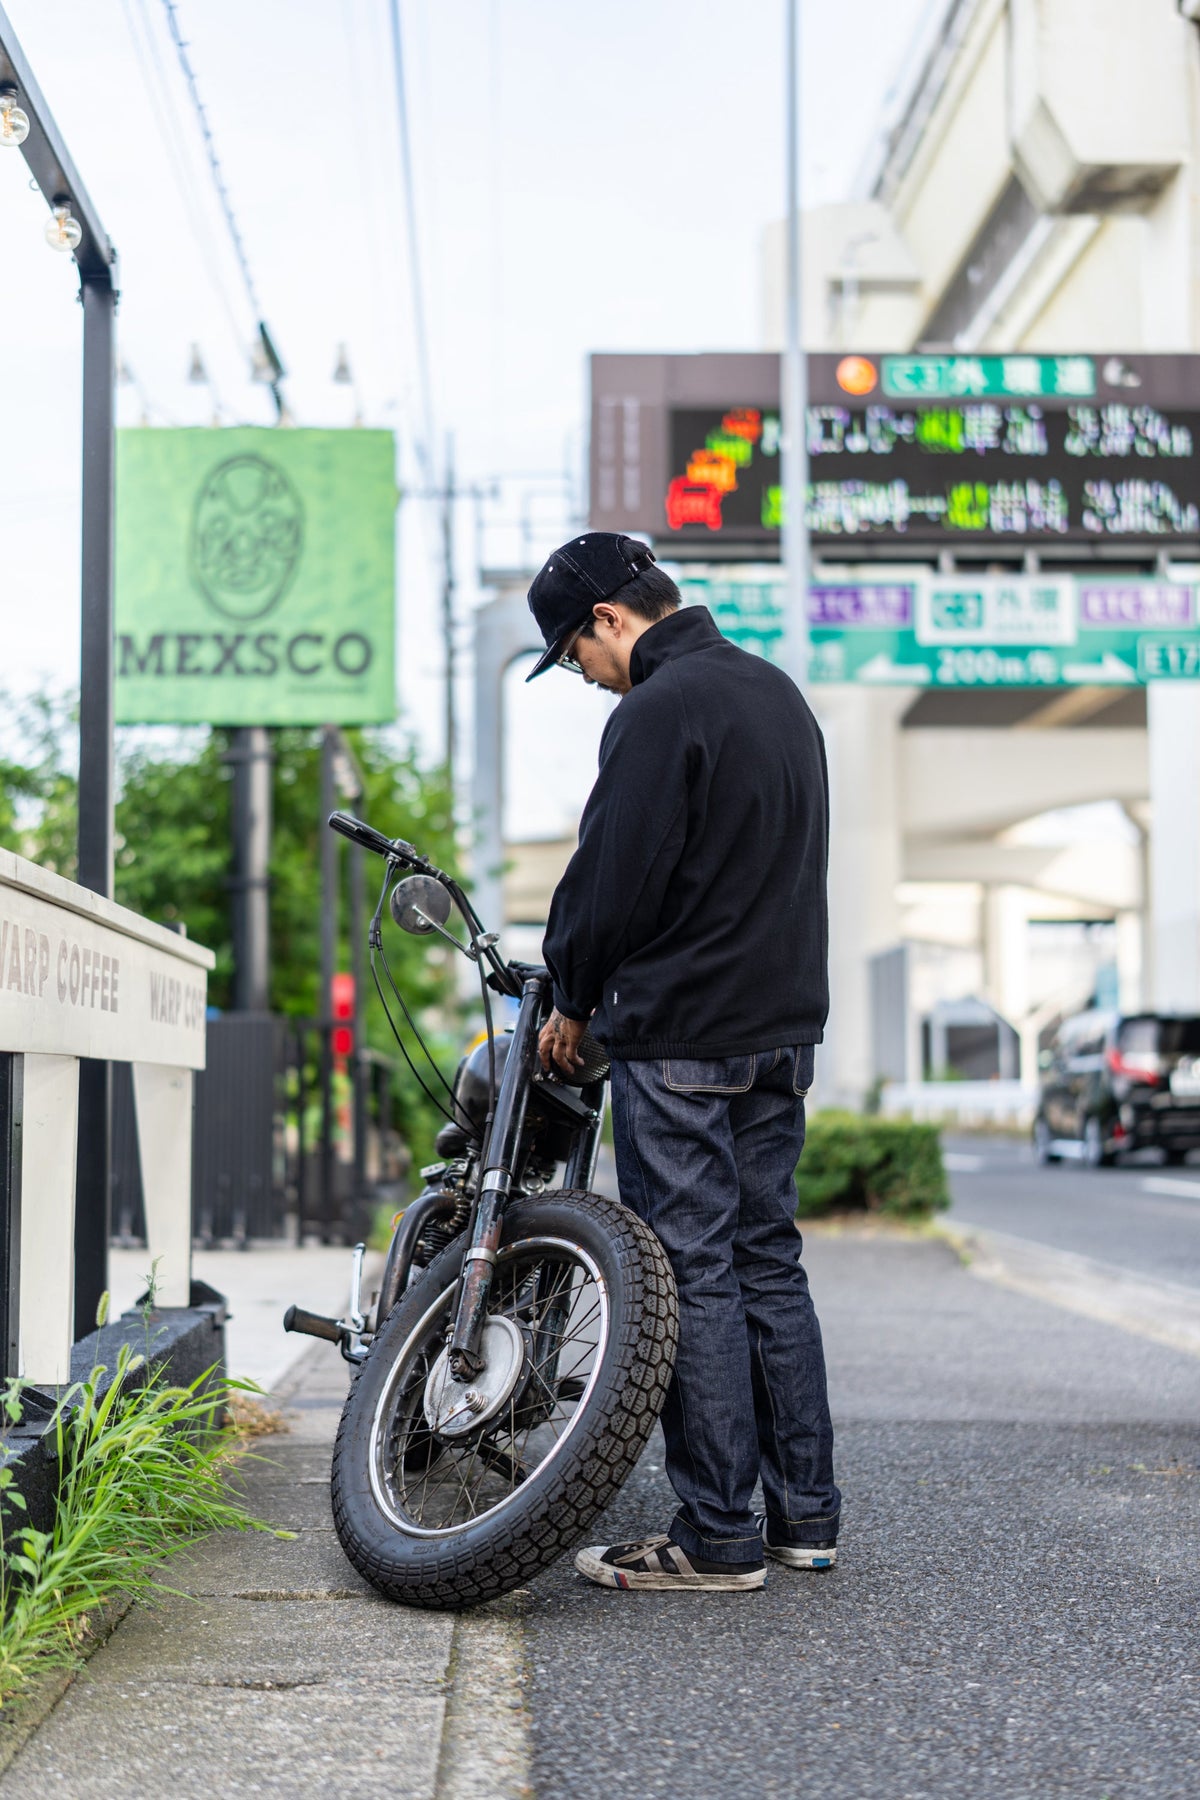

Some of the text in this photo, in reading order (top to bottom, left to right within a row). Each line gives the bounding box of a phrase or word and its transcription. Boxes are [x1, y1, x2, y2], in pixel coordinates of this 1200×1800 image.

[115, 632, 373, 677] MEXSCO
[56, 938, 120, 1014] COFFEE
[149, 969, 182, 1026] WARP
